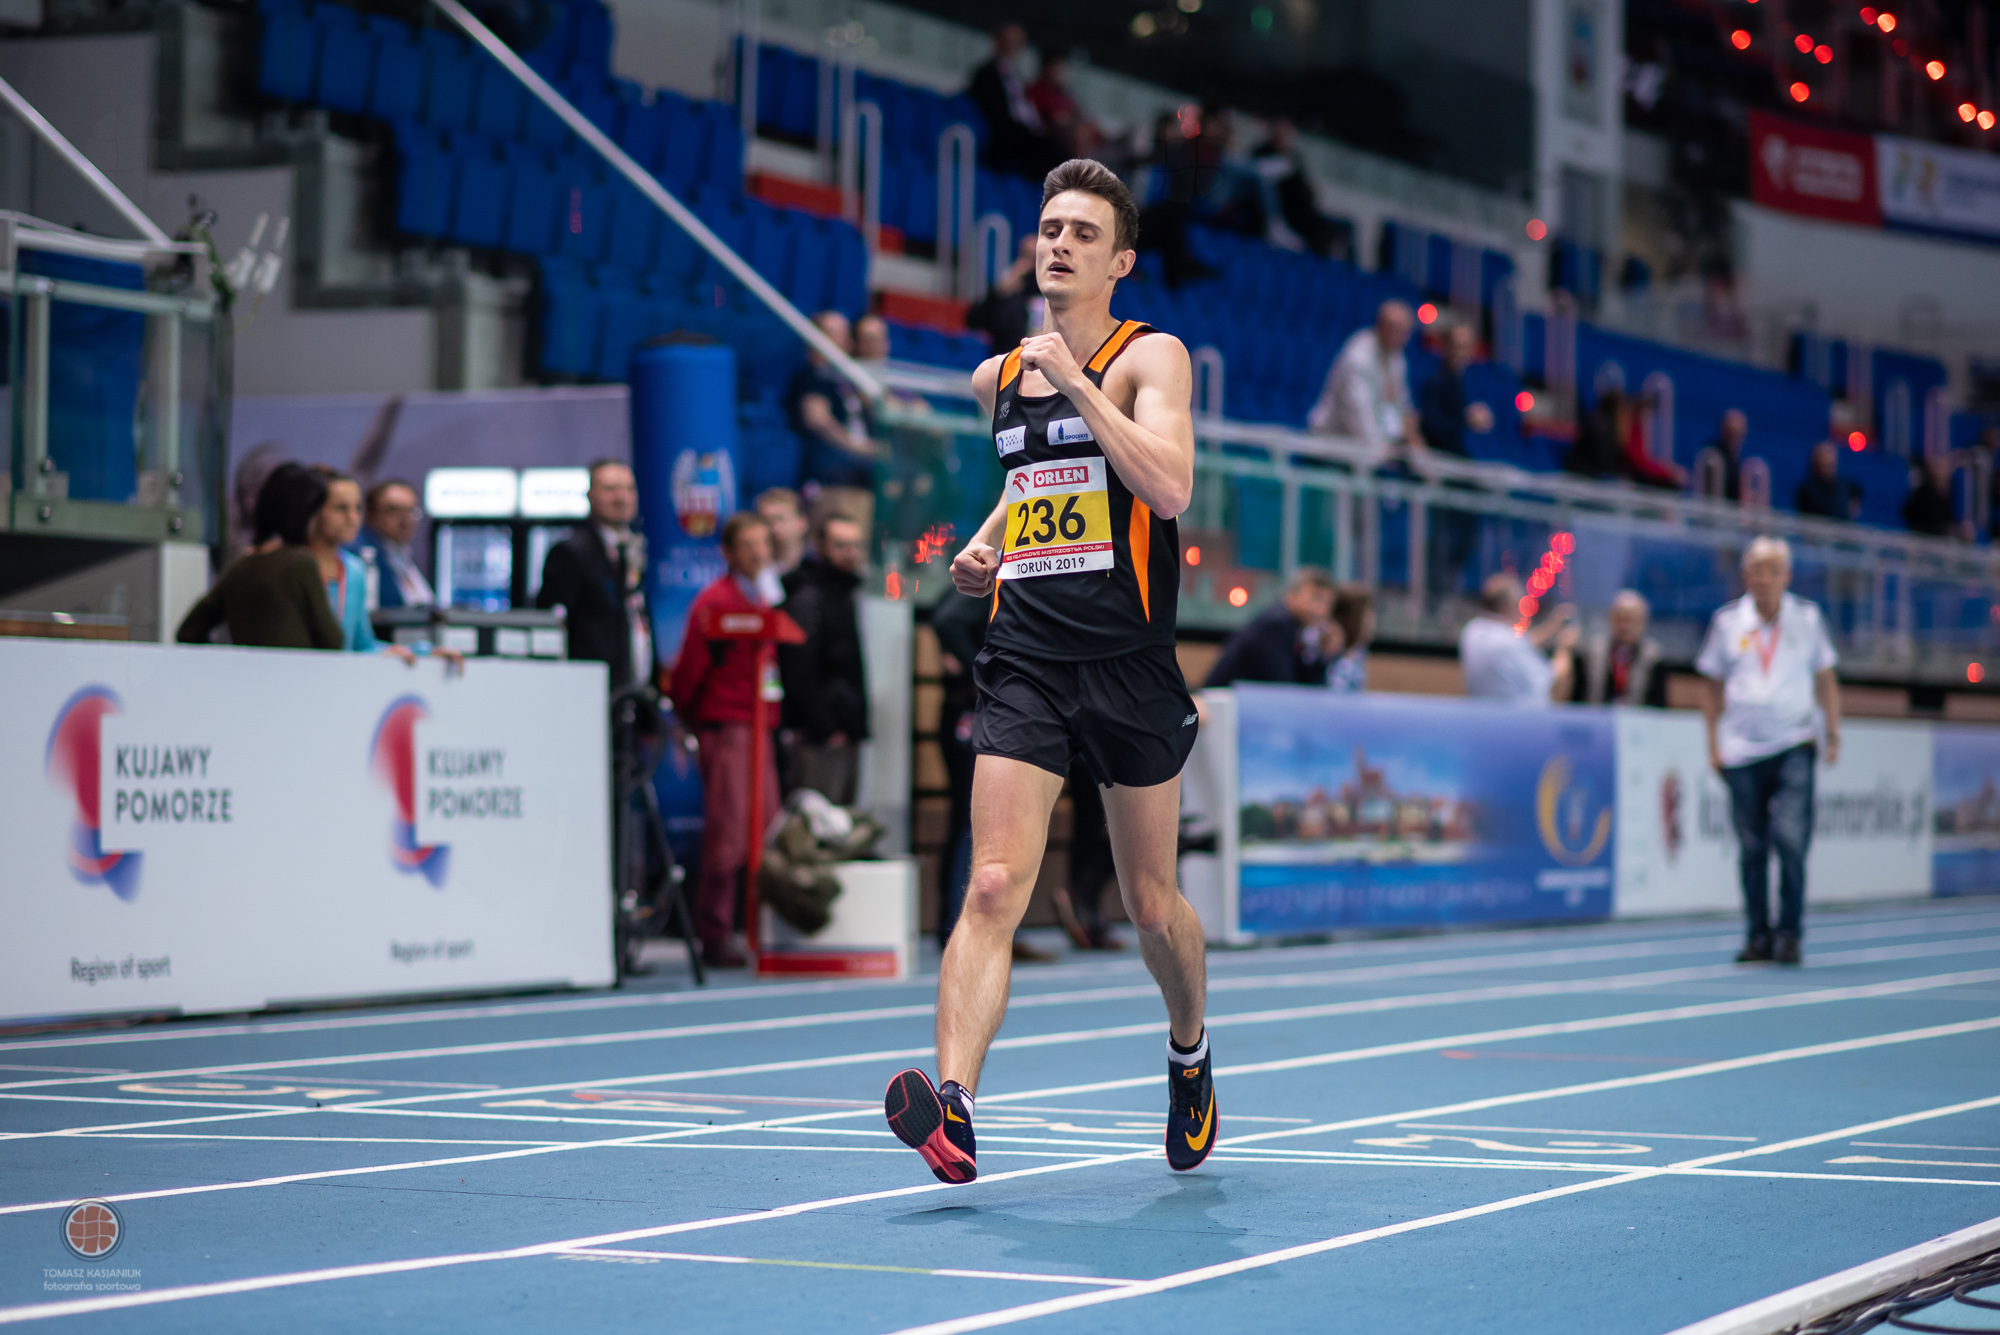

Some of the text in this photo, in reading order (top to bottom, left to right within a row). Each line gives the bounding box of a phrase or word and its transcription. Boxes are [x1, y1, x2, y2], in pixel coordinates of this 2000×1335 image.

[1035, 468, 1086, 486] ORLEN
[1015, 495, 1086, 547] 236
[1017, 557, 1086, 575] TORUŃ 2019
[1021, 549, 1041, 558] HALOWE
[1041, 545, 1083, 555] MISTRZOSTWA
[116, 744, 211, 778] KUJAWY
[428, 747, 506, 778] KUJAWY
[116, 788, 232, 823] POMORZE
[428, 786, 524, 820] POMORZE
[71, 953, 171, 986] Region of sport
